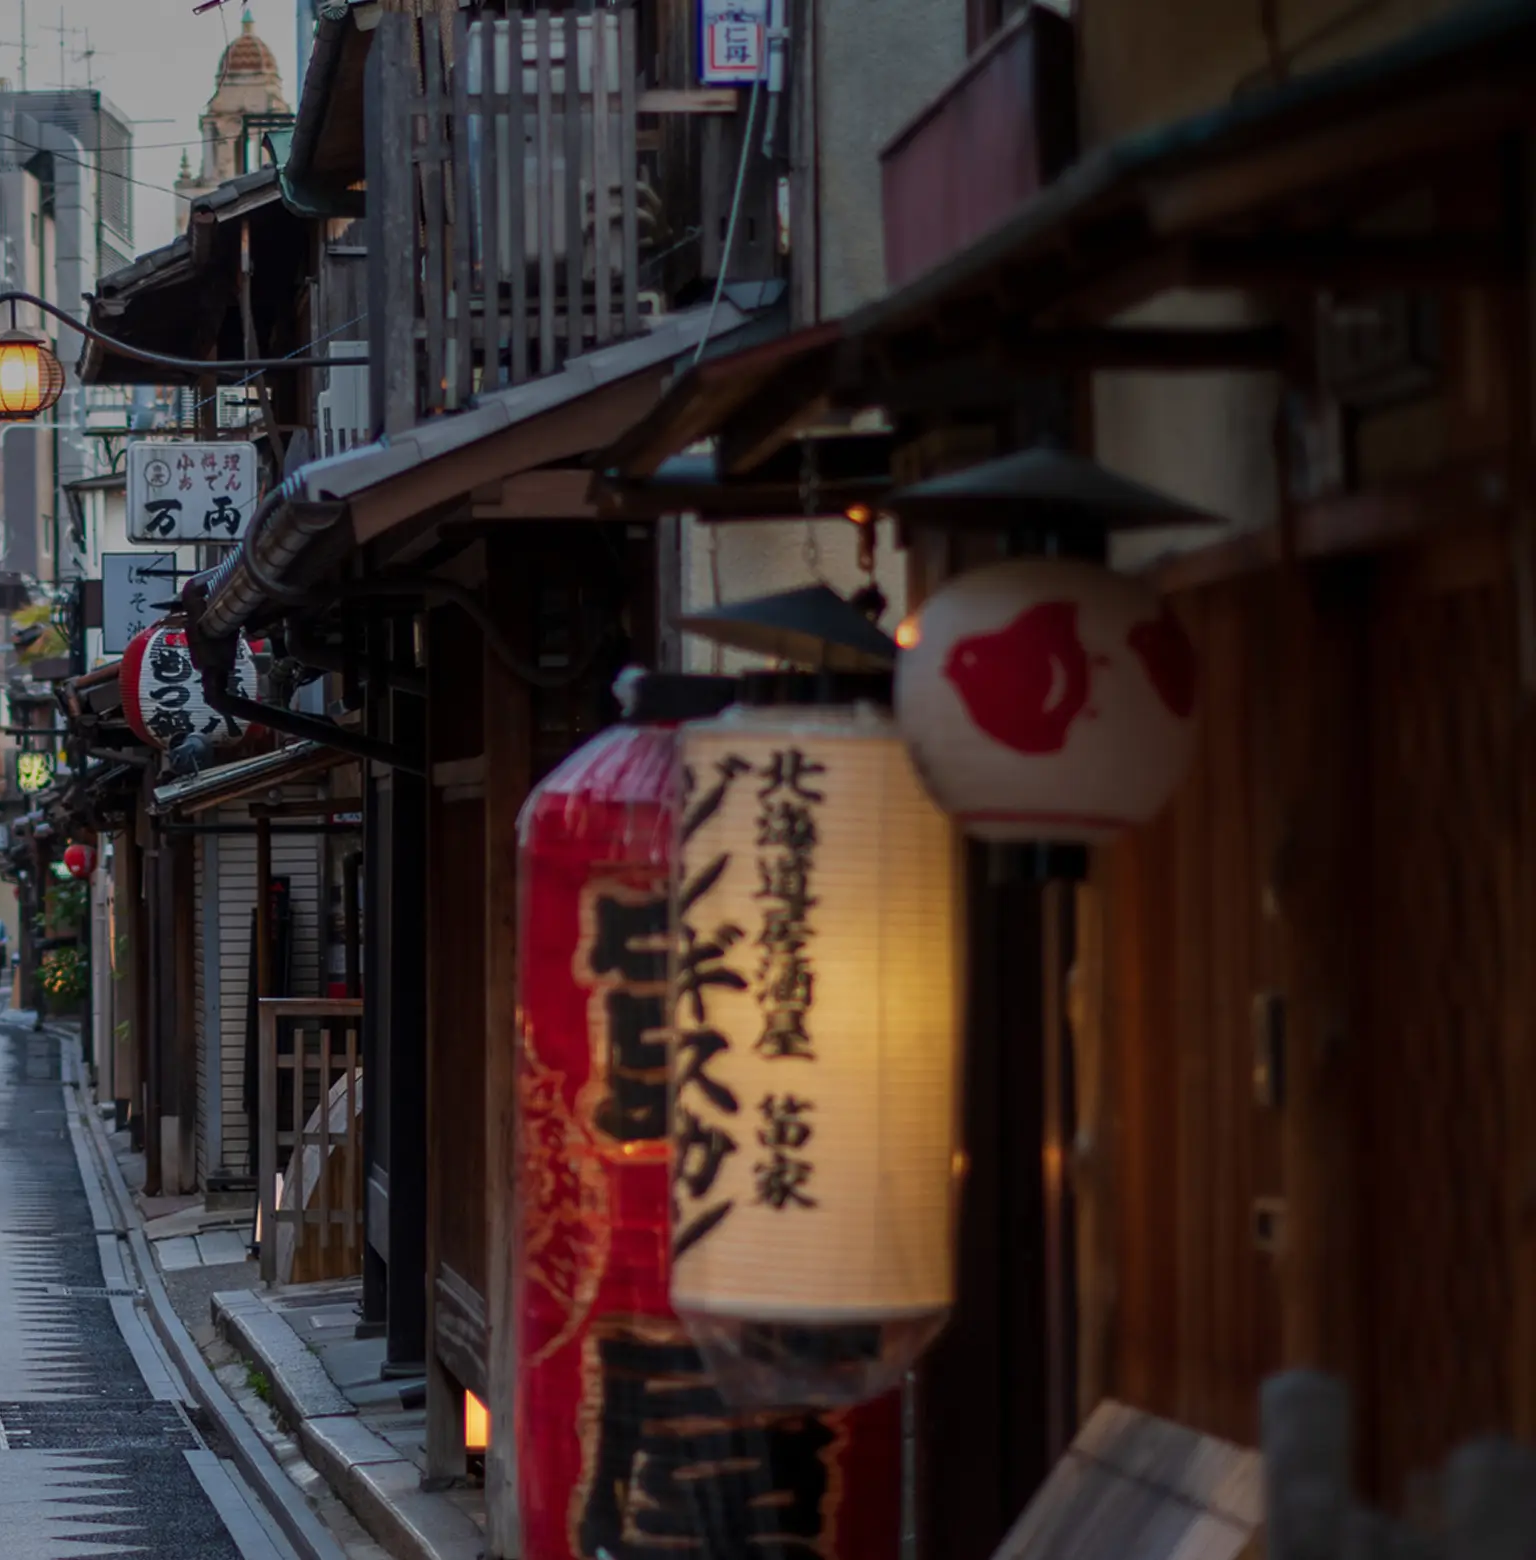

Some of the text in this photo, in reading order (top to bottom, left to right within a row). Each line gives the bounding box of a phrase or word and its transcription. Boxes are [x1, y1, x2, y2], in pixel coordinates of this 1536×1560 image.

[725, 27, 751, 63] 仁丹
[176, 452, 241, 472] 小料理
[178, 471, 242, 491] おでん
[144, 496, 242, 536] 万両
[755, 748, 825, 1060] 北海道居酒屋
